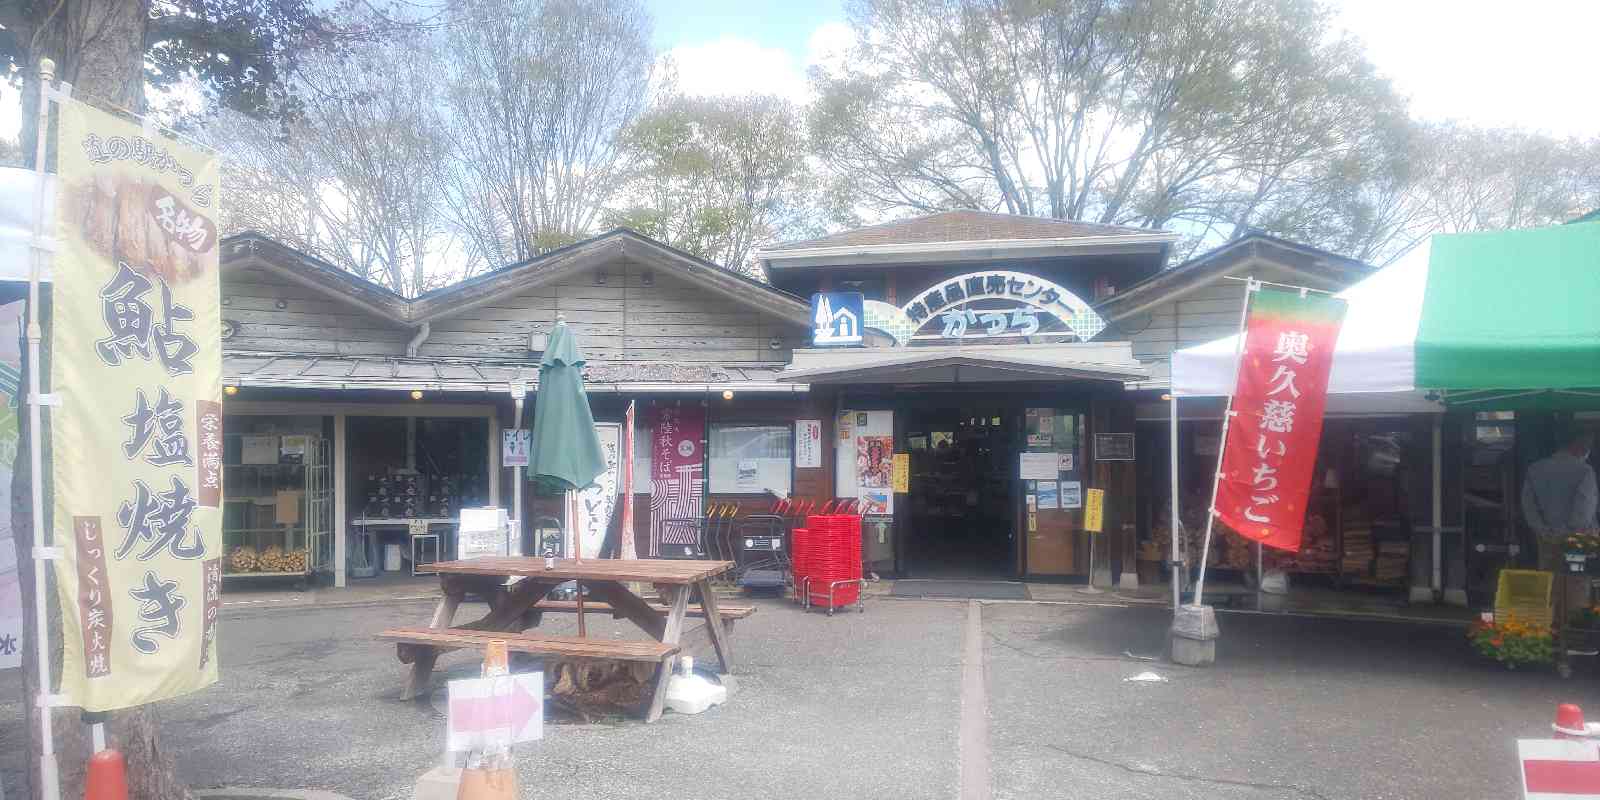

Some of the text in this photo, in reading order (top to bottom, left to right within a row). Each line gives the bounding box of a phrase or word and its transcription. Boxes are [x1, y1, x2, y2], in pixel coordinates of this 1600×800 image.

[155, 196, 208, 250] 名物
[906, 274, 1076, 324] 特産品直売センター
[941, 308, 1040, 338] かつら
[95, 261, 207, 654] 鮎塩焼き
[201, 414, 220, 489] 栄養満点
[504, 430, 529, 441] トイレ
[659, 408, 674, 473] 常陸秋そば
[1244, 331, 1309, 523] 奥久慈いちご
[80, 521, 108, 674] じっくり炭火焼
